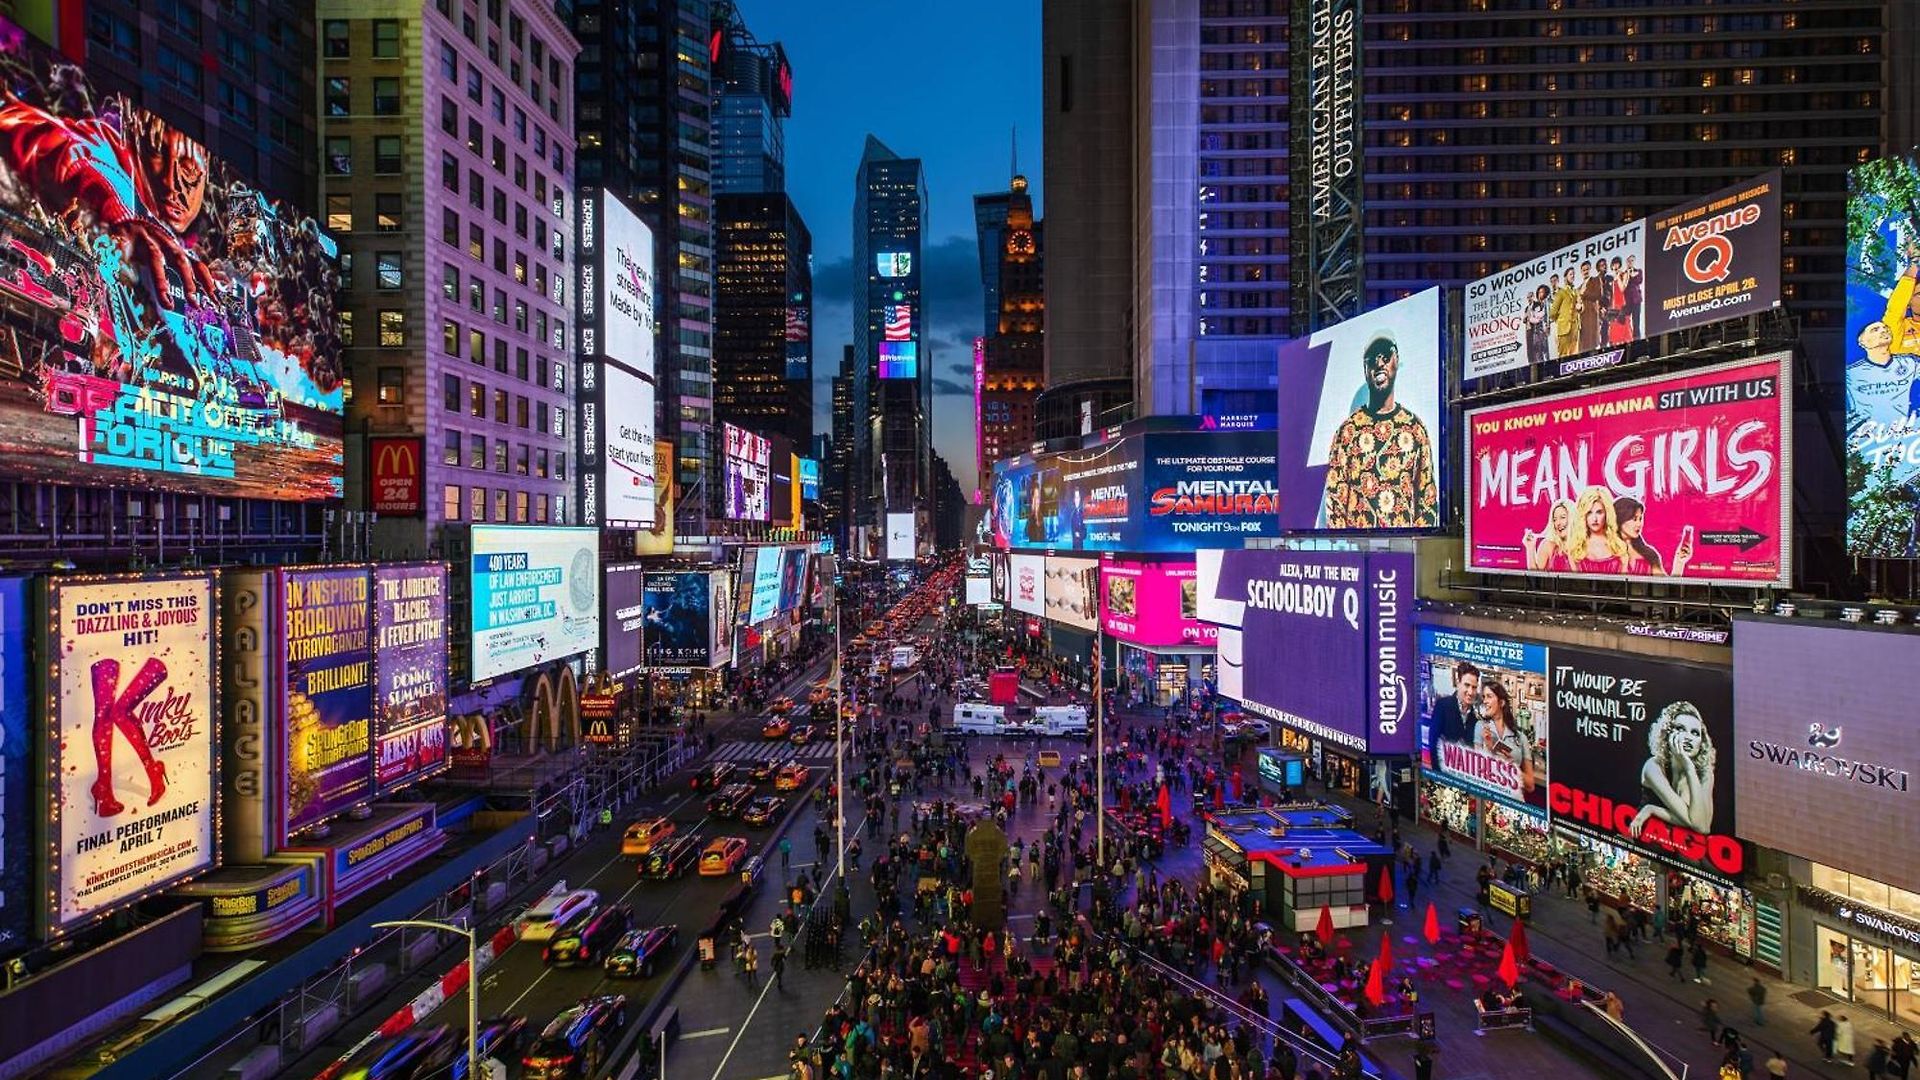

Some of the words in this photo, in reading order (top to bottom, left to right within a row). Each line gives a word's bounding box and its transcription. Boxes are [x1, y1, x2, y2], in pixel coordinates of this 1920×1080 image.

[1313, 0, 1330, 69] EAGL
[1334, 9, 1353, 178] OUTFITTERS
[1313, 75, 1330, 218] AMERICAN
[1738, 184, 1769, 202] MUSICAL
[1663, 204, 1761, 251] Avenue
[616, 246, 631, 271] The
[1470, 283, 1487, 299] SO
[1491, 260, 1547, 292] WRONG
[1552, 248, 1580, 271] IT'S
[1585, 226, 1641, 258] RIGHT
[1683, 233, 1734, 284] Q
[610, 290, 632, 317] Made
[633, 304, 643, 328] by
[1473, 302, 1488, 312] THE
[1489, 286, 1518, 307] PLAY
[1663, 294, 1687, 311] MUST
[1688, 288, 1714, 303] CLOSE
[1715, 281, 1740, 295] APRIL
[1668, 292, 1752, 320] AvenueQ.com
[1469, 311, 1490, 324] THAT
[1491, 300, 1522, 320] GOES
[1468, 315, 1521, 339] WRONG
[1565, 352, 1616, 373] OUTFRONT
[1476, 421, 1500, 436] YOU
[1504, 414, 1547, 431] KNOW
[1552, 410, 1583, 424] YOU
[1588, 396, 1657, 418] WANNA
[1659, 391, 1684, 409] SIT
[1690, 386, 1739, 406] WITH
[1745, 379, 1775, 398] US.
[620, 425, 631, 439] Get
[632, 428, 642, 443] the
[609, 444, 625, 460] Start
[626, 449, 640, 464] your
[1172, 457, 1206, 465] ULTIMATE
[1207, 456, 1245, 465] OBSTACLE
[1245, 456, 1276, 464] COURSE
[1479, 441, 1590, 509] MEAN
[1604, 421, 1774, 503] GIRLS
[380, 478, 413, 487] OPEN
[1186, 465, 1202, 473] FOR
[1203, 465, 1224, 473] YOUR
[1224, 465, 1244, 473] MIND
[383, 487, 409, 500] 24
[1091, 484, 1129, 500] MENTAL
[1150, 487, 1280, 516] SAMURAI
[1176, 480, 1280, 496] MENTAL
[376, 502, 417, 511] HOURS
[1172, 522, 1222, 532] TONIGHT
[1223, 522, 1240, 532] 9PM
[1241, 522, 1262, 532] FOX
[489, 555, 502, 572] 400
[503, 554, 526, 571] YEARS
[1280, 563, 1303, 580] ALEXA,
[1304, 565, 1321, 579] PLAY
[1323, 565, 1339, 581] THE
[1340, 566, 1360, 582] NEW
[306, 576, 367, 607] INSPIRED
[401, 576, 440, 599] AUDIENCE
[489, 572, 499, 590] OF
[500, 571, 516, 588] LAW
[516, 568, 561, 588] ENFORCEMENT
[76, 601, 124, 616] DON'T
[127, 598, 163, 613] MISS
[166, 595, 197, 609] THIS
[393, 599, 430, 623] REACHES
[489, 590, 508, 608] JUST
[509, 587, 538, 606] ARRIVED
[1247, 579, 1337, 618] SCHOOLBOY
[1343, 587, 1359, 630] Q
[1373, 569, 1397, 642] music
[71, 612, 139, 635] "DAZZLING
[141, 612, 152, 628] &
[154, 607, 201, 627] JOYOUS"
[286, 602, 367, 640] BROADWAY
[489, 610, 497, 627] IN
[1183, 627, 1200, 638] ON
[123, 629, 159, 647] HIT!
[287, 629, 368, 662] XTRAVAGANZA!
[380, 627, 387, 649] A
[388, 623, 414, 647] FEVER
[1434, 637, 1461, 650] JOEY
[1464, 641, 1524, 661] McINTYRE
[234, 589, 258, 796] PALACE
[388, 682, 437, 706] SUMMER
[393, 670, 431, 691] DONNA
[1379, 646, 1397, 735] amazon
[1555, 666, 1573, 686] IT
[1573, 670, 1617, 695] WOULD
[1620, 678, 1649, 697] BE
[1556, 690, 1627, 720] CRIMINAL
[1627, 702, 1646, 722] TO
[148, 716, 201, 748] Boots
[307, 719, 369, 757] SPONGEBOB
[1576, 716, 1608, 739] MISS
[1612, 724, 1631, 743] IT
[307, 738, 369, 771] SQUAREPANTS
[380, 729, 419, 767] JERSEY
[1442, 741, 1519, 791] WAITRESS
[1749, 739, 1910, 792] SWAROVSKI
[76, 830, 114, 854] FINAL
[116, 800, 200, 840] PERFORMANCE
[119, 834, 154, 854] APRIL
[156, 826, 164, 841] 7
[1550, 781, 1744, 876] CHICAGO
[348, 837, 385, 865] SPONGEBOB
[213, 895, 257, 911] SPONGEBOB
[1855, 912, 1920, 944] SWAROVS
